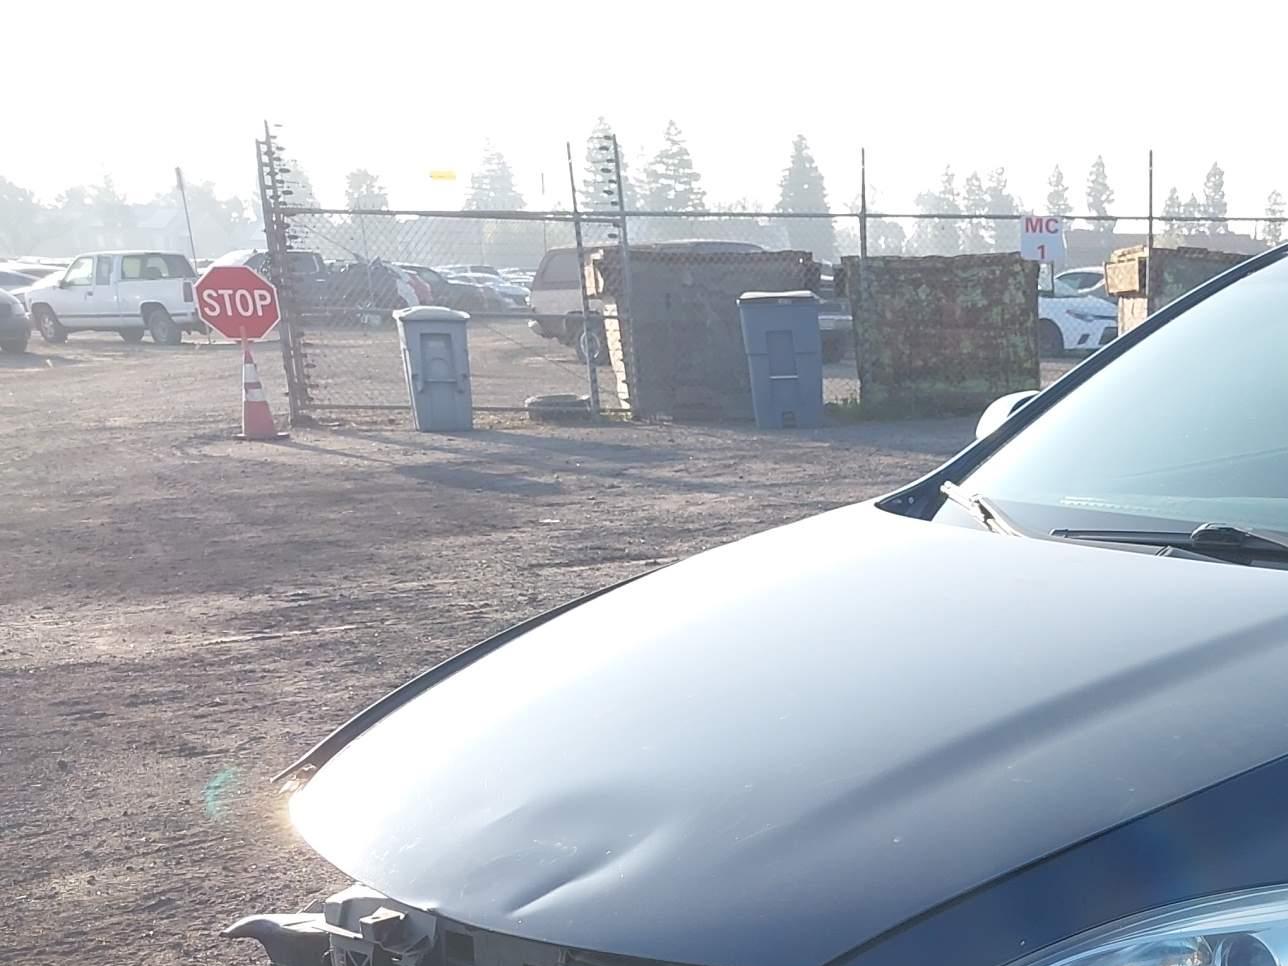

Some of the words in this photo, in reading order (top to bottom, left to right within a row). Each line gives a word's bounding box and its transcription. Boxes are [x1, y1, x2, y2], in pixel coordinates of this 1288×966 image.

[1025, 217, 1059, 234] MC
[1037, 244, 1046, 260] 1
[202, 288, 272, 317] STOP
